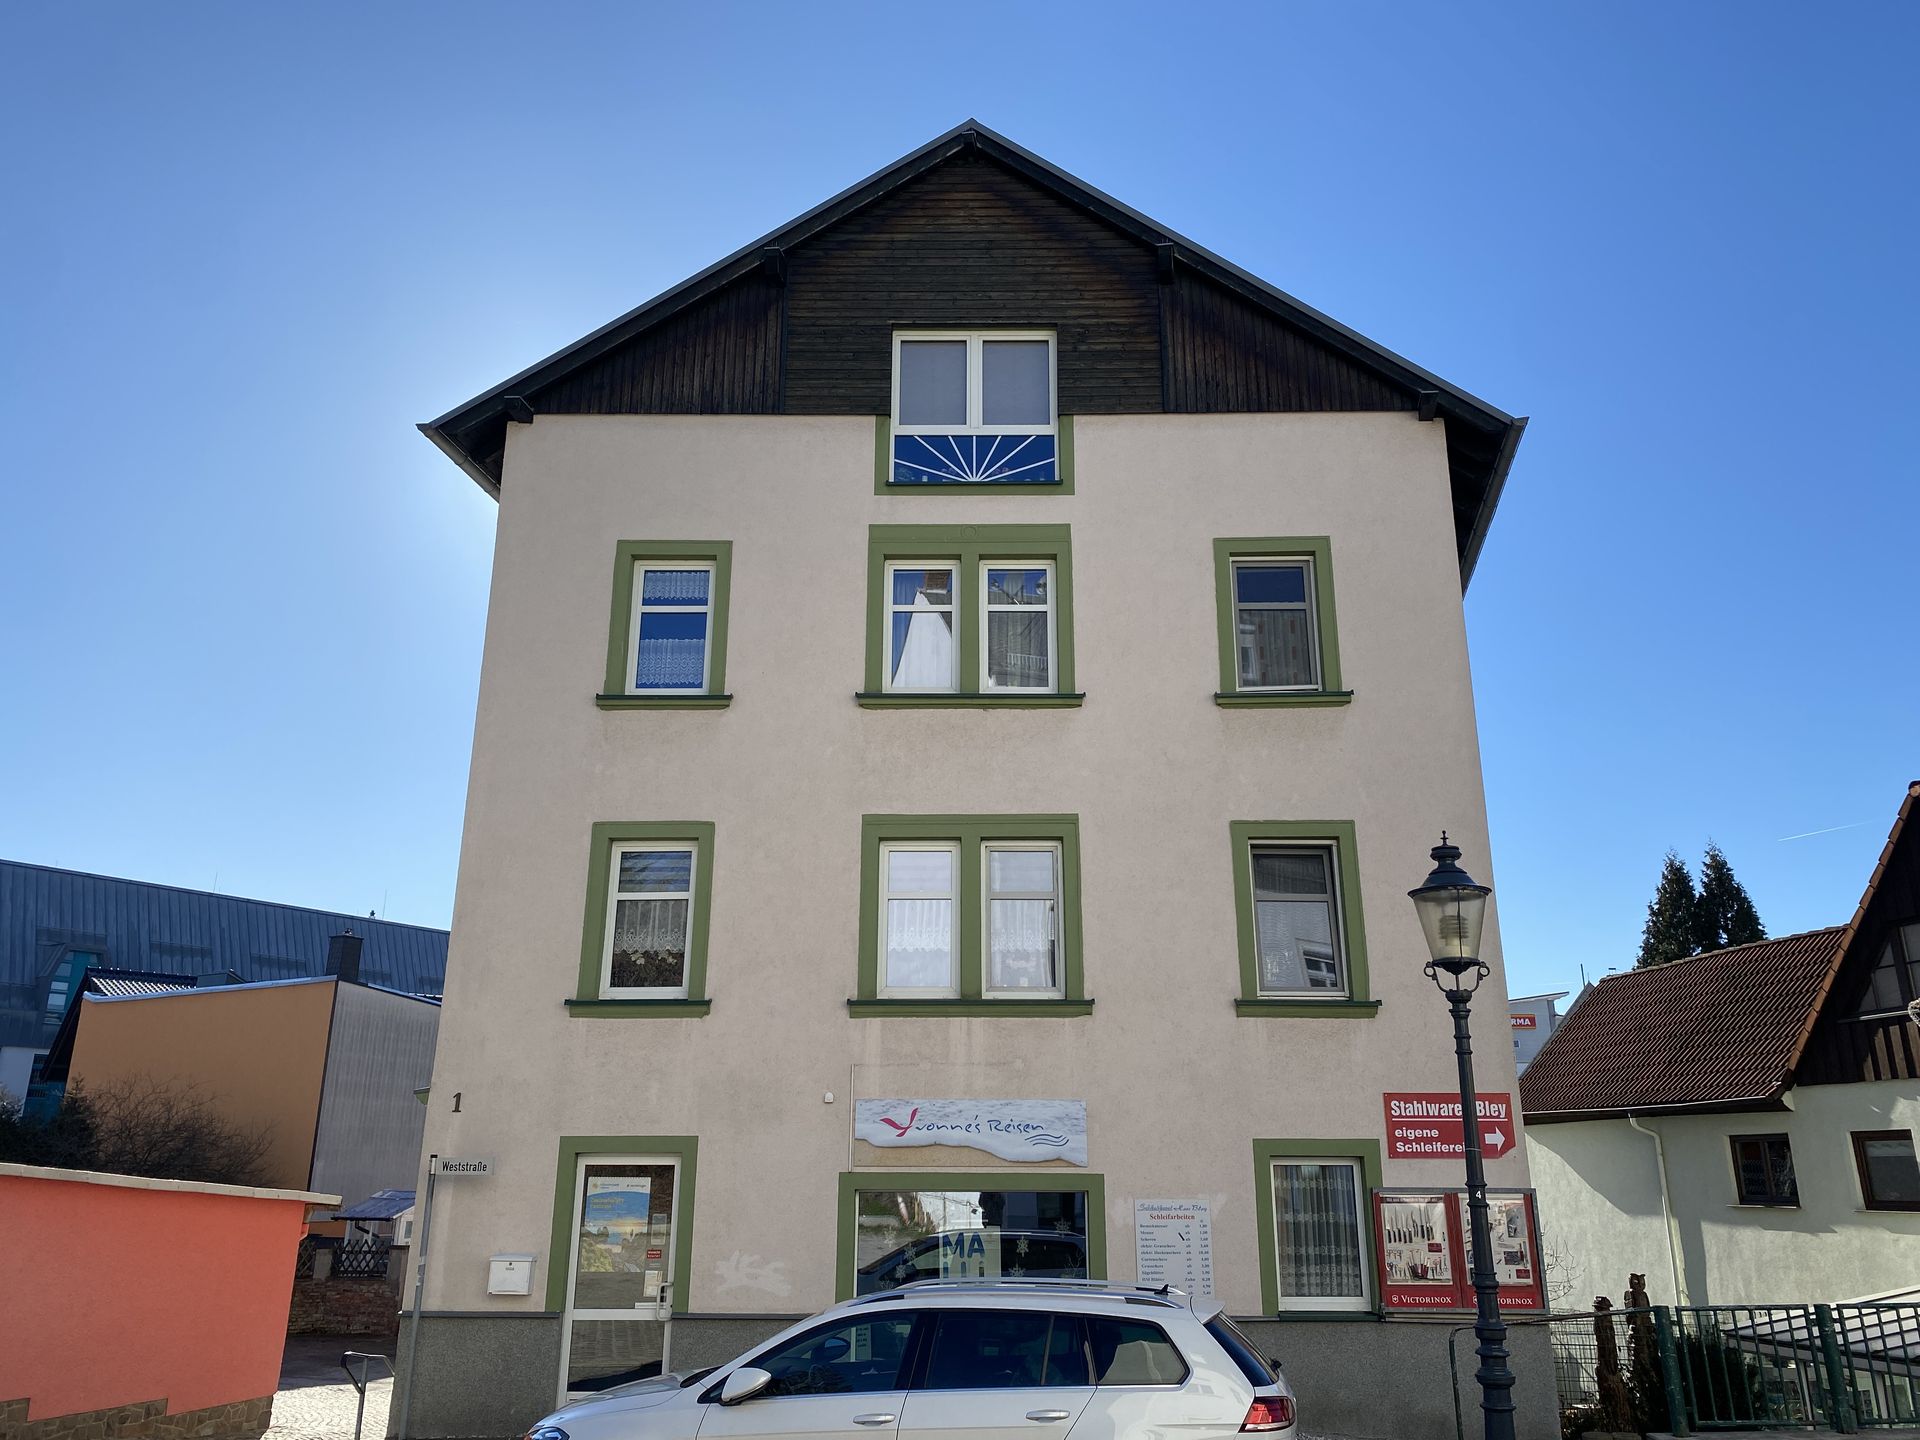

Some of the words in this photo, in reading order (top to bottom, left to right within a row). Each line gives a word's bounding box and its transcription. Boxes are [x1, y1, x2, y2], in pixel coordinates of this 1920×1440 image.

[451, 1092, 462, 1113] 1
[1390, 1100, 1463, 1117] Stahlware
[1475, 1100, 1506, 1118] Bley
[987, 1118, 1044, 1133] Reisen
[1394, 1127, 1439, 1138] eigene
[442, 1160, 487, 1172] Weststraße
[1475, 1190, 1482, 1199] 4
[1400, 1294, 1452, 1304] VICTORINOX
[1497, 1297, 1533, 1305] TORINOX
